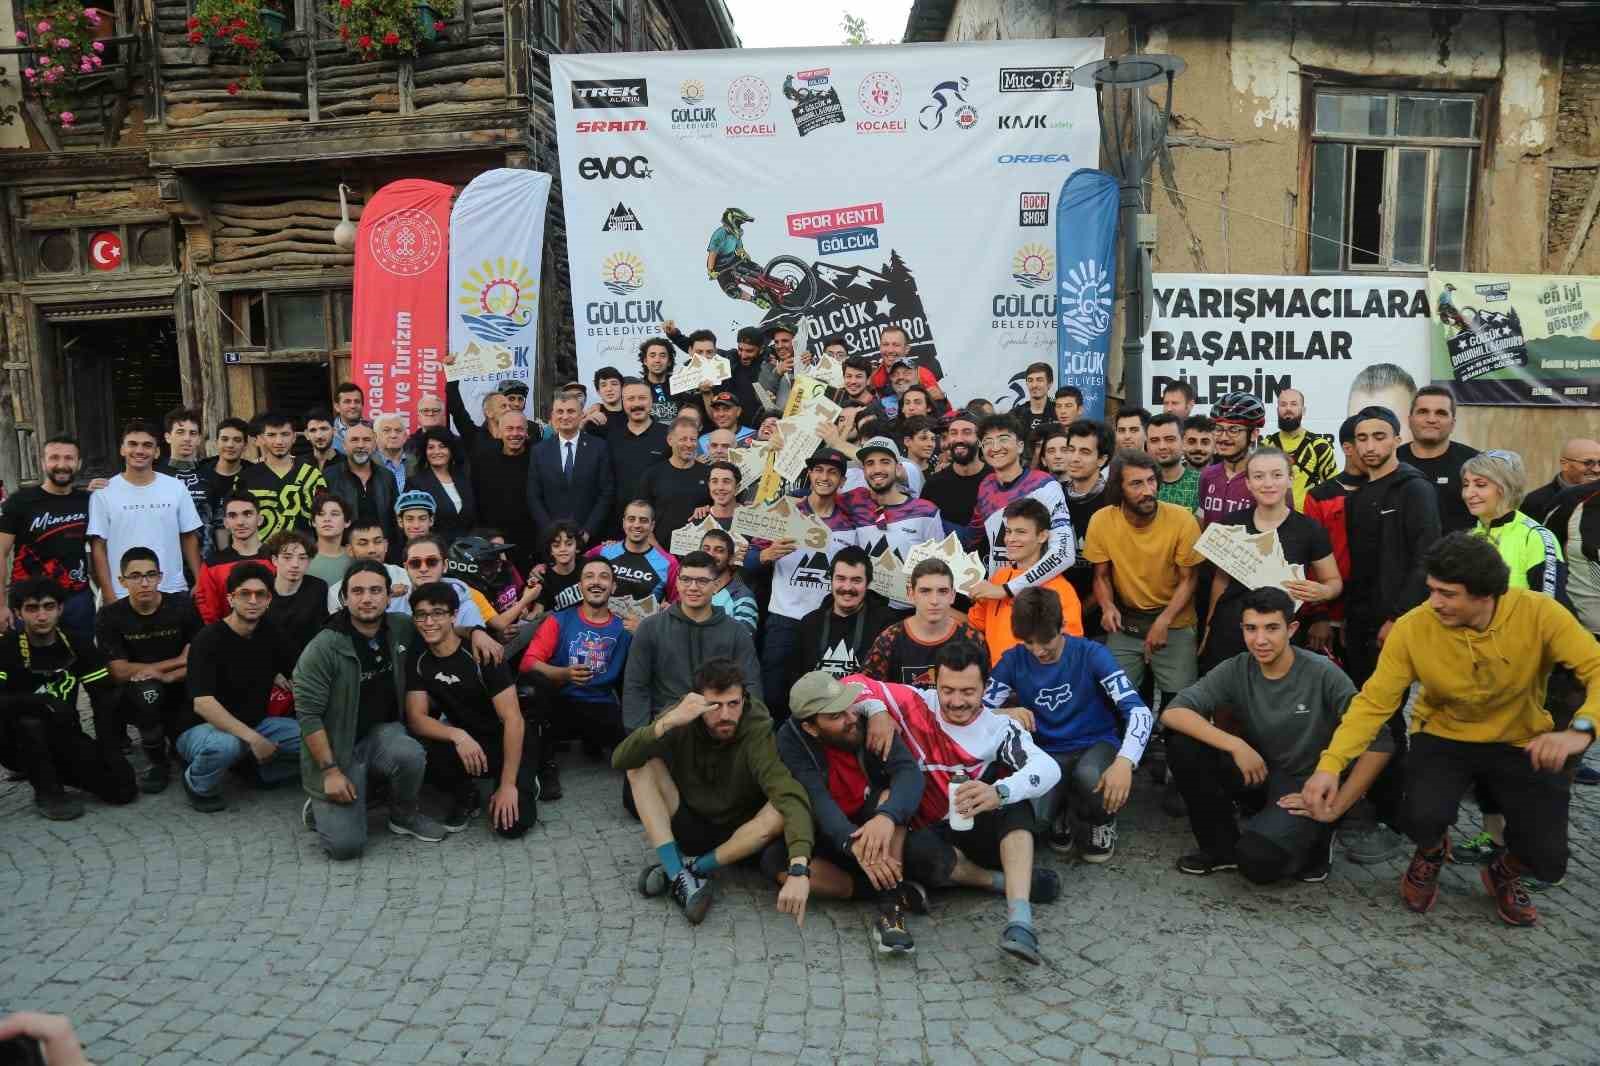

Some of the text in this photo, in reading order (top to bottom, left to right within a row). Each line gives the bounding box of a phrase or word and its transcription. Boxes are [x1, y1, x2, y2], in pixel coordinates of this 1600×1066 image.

[1004, 70, 1071, 89] Muc-Off
[576, 86, 641, 97] TREK
[575, 120, 648, 133] SRAM
[726, 123, 776, 135] KOCAELİ
[856, 119, 907, 131] KOCAELİ
[998, 114, 1047, 129] KASK
[998, 154, 1070, 164] ORBEA
[1023, 193, 1047, 208] ROCK
[791, 206, 880, 231] SPOR KENTİ
[821, 232, 877, 253] GÖLCÜK
[586, 299, 665, 325] GÖLCÜK
[992, 293, 1057, 317] GÖLCÜ
[1152, 287, 1431, 323] YARIŞMACILARA
[587, 325, 662, 336] BELEDİYES
[808, 301, 874, 340] ÖLCÜK
[992, 320, 1058, 329] BELEDİYE
[391, 311, 411, 378] Turizm
[1152, 330, 1353, 366] BAŞARILAR
[363, 362, 384, 421] ocaeli
[395, 381, 411, 404] ve
[804, 527, 828, 549] 3
[553, 583, 585, 612] JORD
